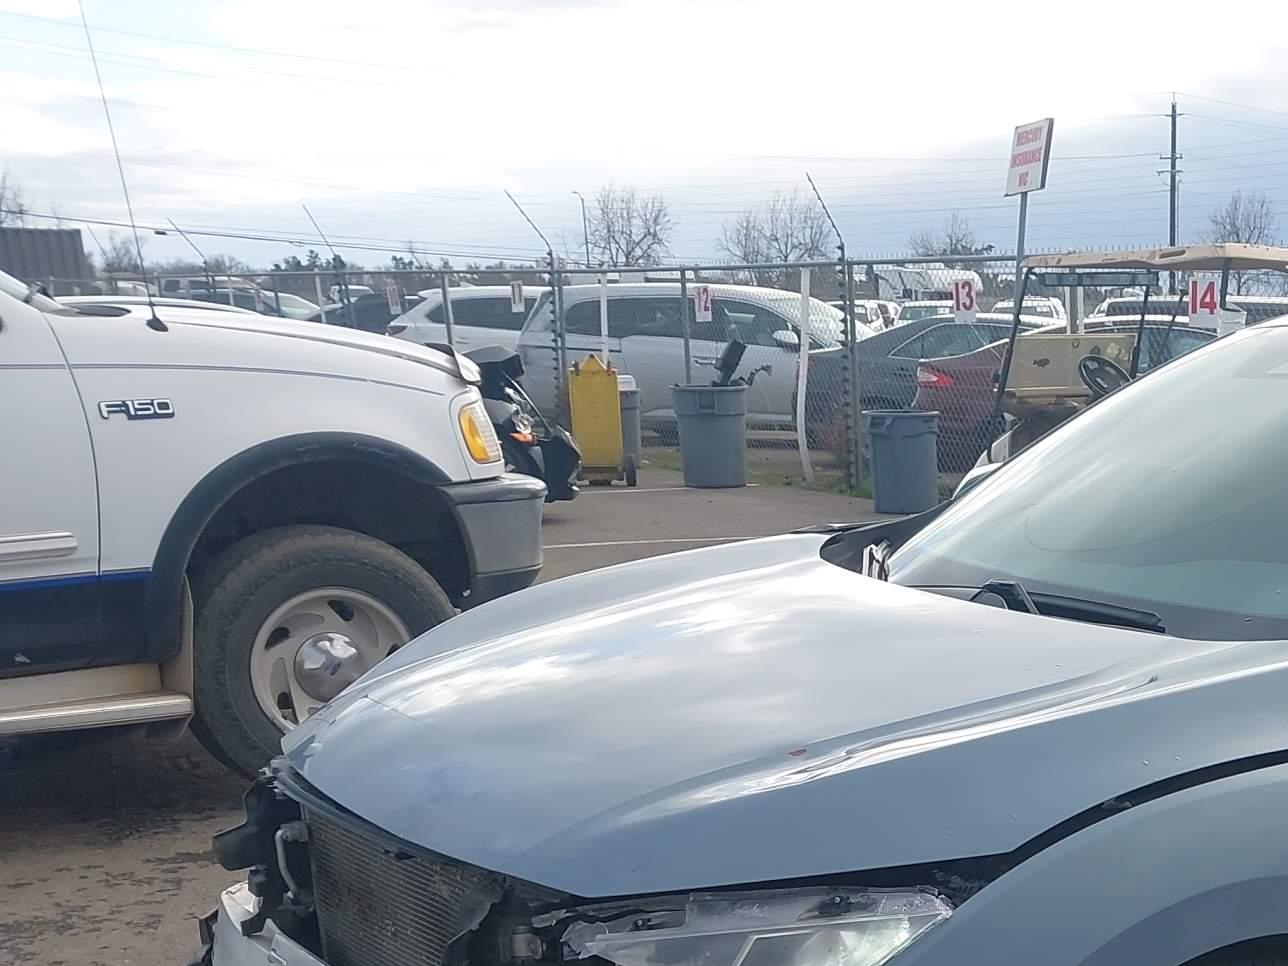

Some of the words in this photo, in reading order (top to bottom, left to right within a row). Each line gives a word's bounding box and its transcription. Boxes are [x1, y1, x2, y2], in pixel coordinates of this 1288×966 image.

[696, 287, 711, 312] 12
[954, 280, 975, 312] 13
[1190, 280, 1218, 315] 14
